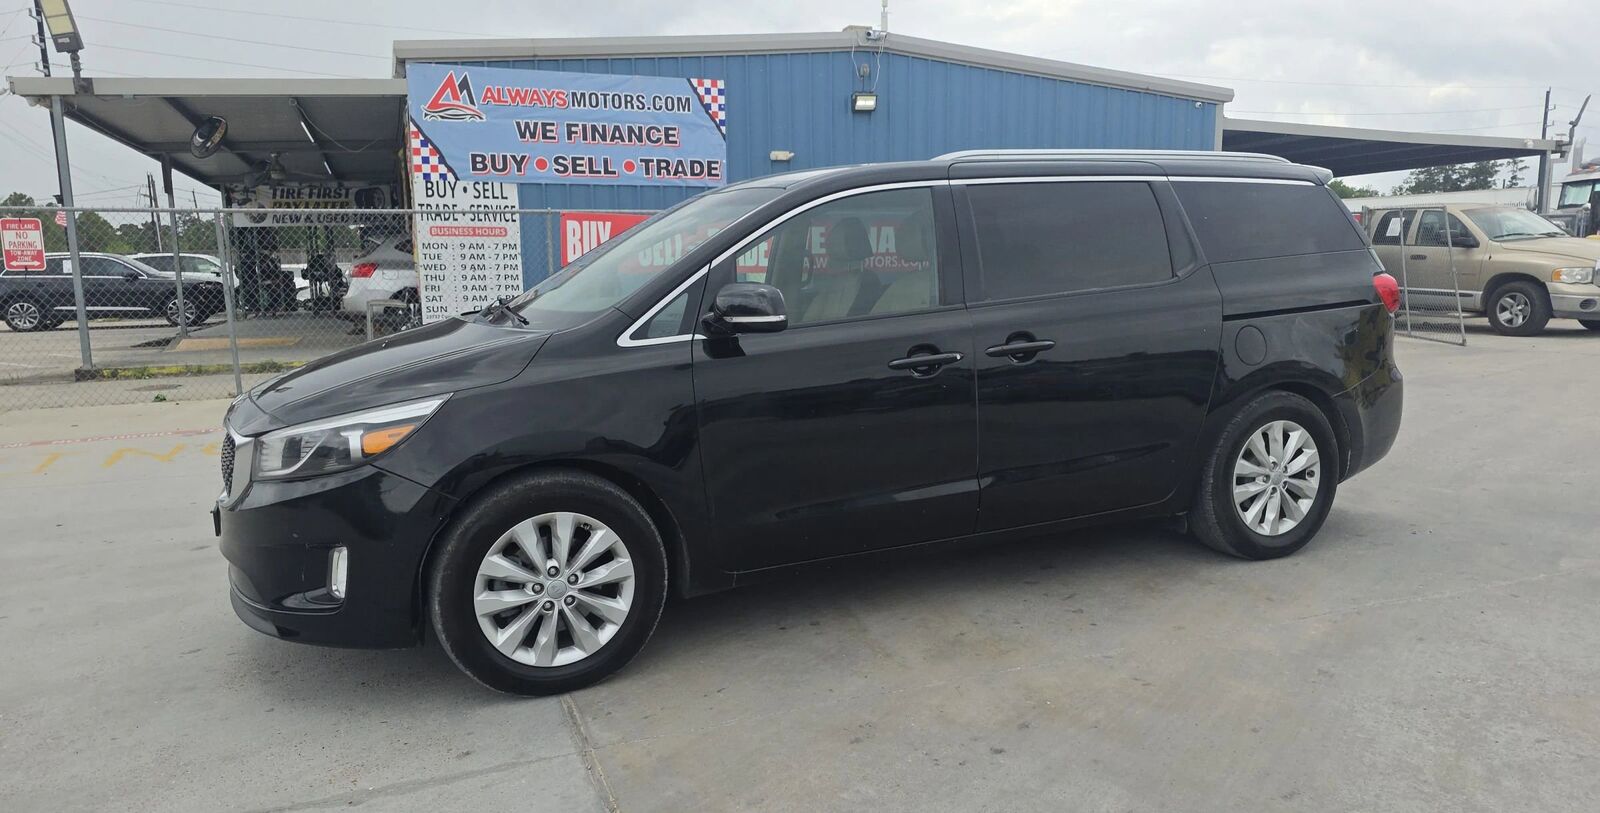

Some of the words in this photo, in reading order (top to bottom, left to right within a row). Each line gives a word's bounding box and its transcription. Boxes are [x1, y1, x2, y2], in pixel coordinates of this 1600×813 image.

[480, 85, 692, 113] ALWAYSMOTORS.COM
[514, 120, 557, 142] WE
[565, 122, 680, 146] FINANCE
[470, 153, 528, 174] BUY
[553, 155, 619, 178] SELL
[639, 157, 722, 179] TRADE
[272, 187, 304, 200] TIRE
[308, 187, 351, 200] FIRST
[425, 180, 458, 198] BUY
[473, 181, 508, 200] SELL
[272, 213, 302, 224] NEW
[418, 203, 458, 221] TRADE
[469, 204, 517, 223] SERVICE
[431, 227, 474, 236] BUSINESS
[475, 227, 506, 236] HOURS
[8, 241, 37, 249] PARKING
[567, 220, 612, 264] BUY
[422, 253, 442, 261] TUE
[460, 253, 466, 261] 9
[469, 253, 485, 261] AM
[494, 253, 500, 261] 7
[503, 253, 518, 261] PM
[424, 274, 446, 282] THU
[461, 274, 468, 282] 9
[470, 274, 487, 282] AM
[495, 274, 501, 282] 7
[504, 274, 519, 282] PM
[505, 284, 520, 292] PM
[425, 295, 444, 303] SAT
[462, 295, 469, 303] 9
[471, 295, 488, 303] AM
[426, 305, 448, 313] SUN
